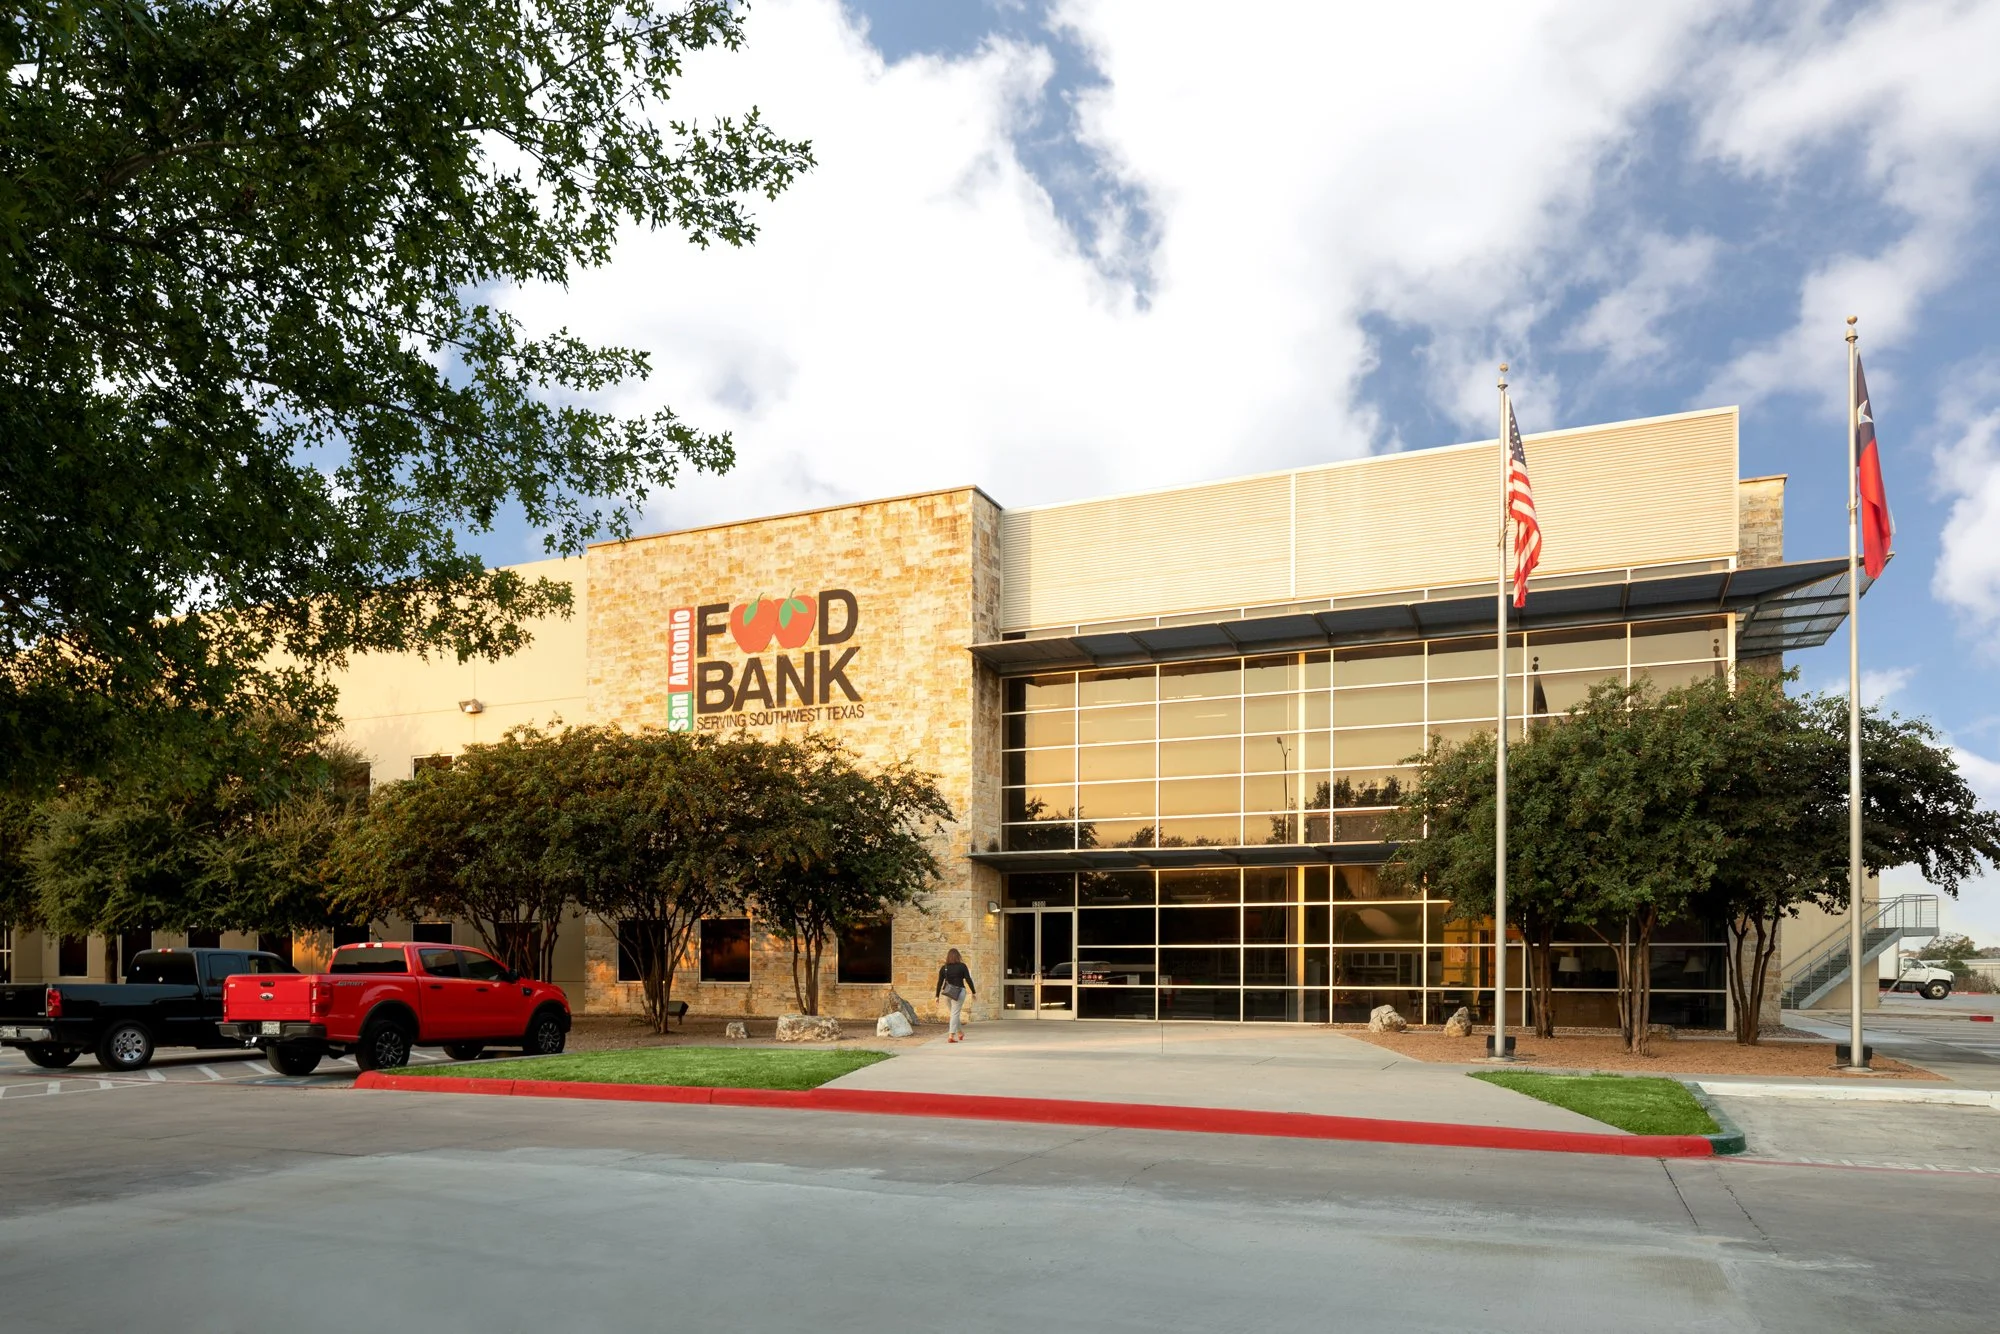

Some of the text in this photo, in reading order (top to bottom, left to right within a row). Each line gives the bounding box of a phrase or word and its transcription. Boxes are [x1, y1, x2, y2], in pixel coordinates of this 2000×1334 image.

[697, 589, 858, 657] FOOD
[669, 610, 691, 731] San Antonio
[697, 646, 863, 714] BANK
[697, 704, 865, 730] SERVING SOUTHWEST TEXAS
